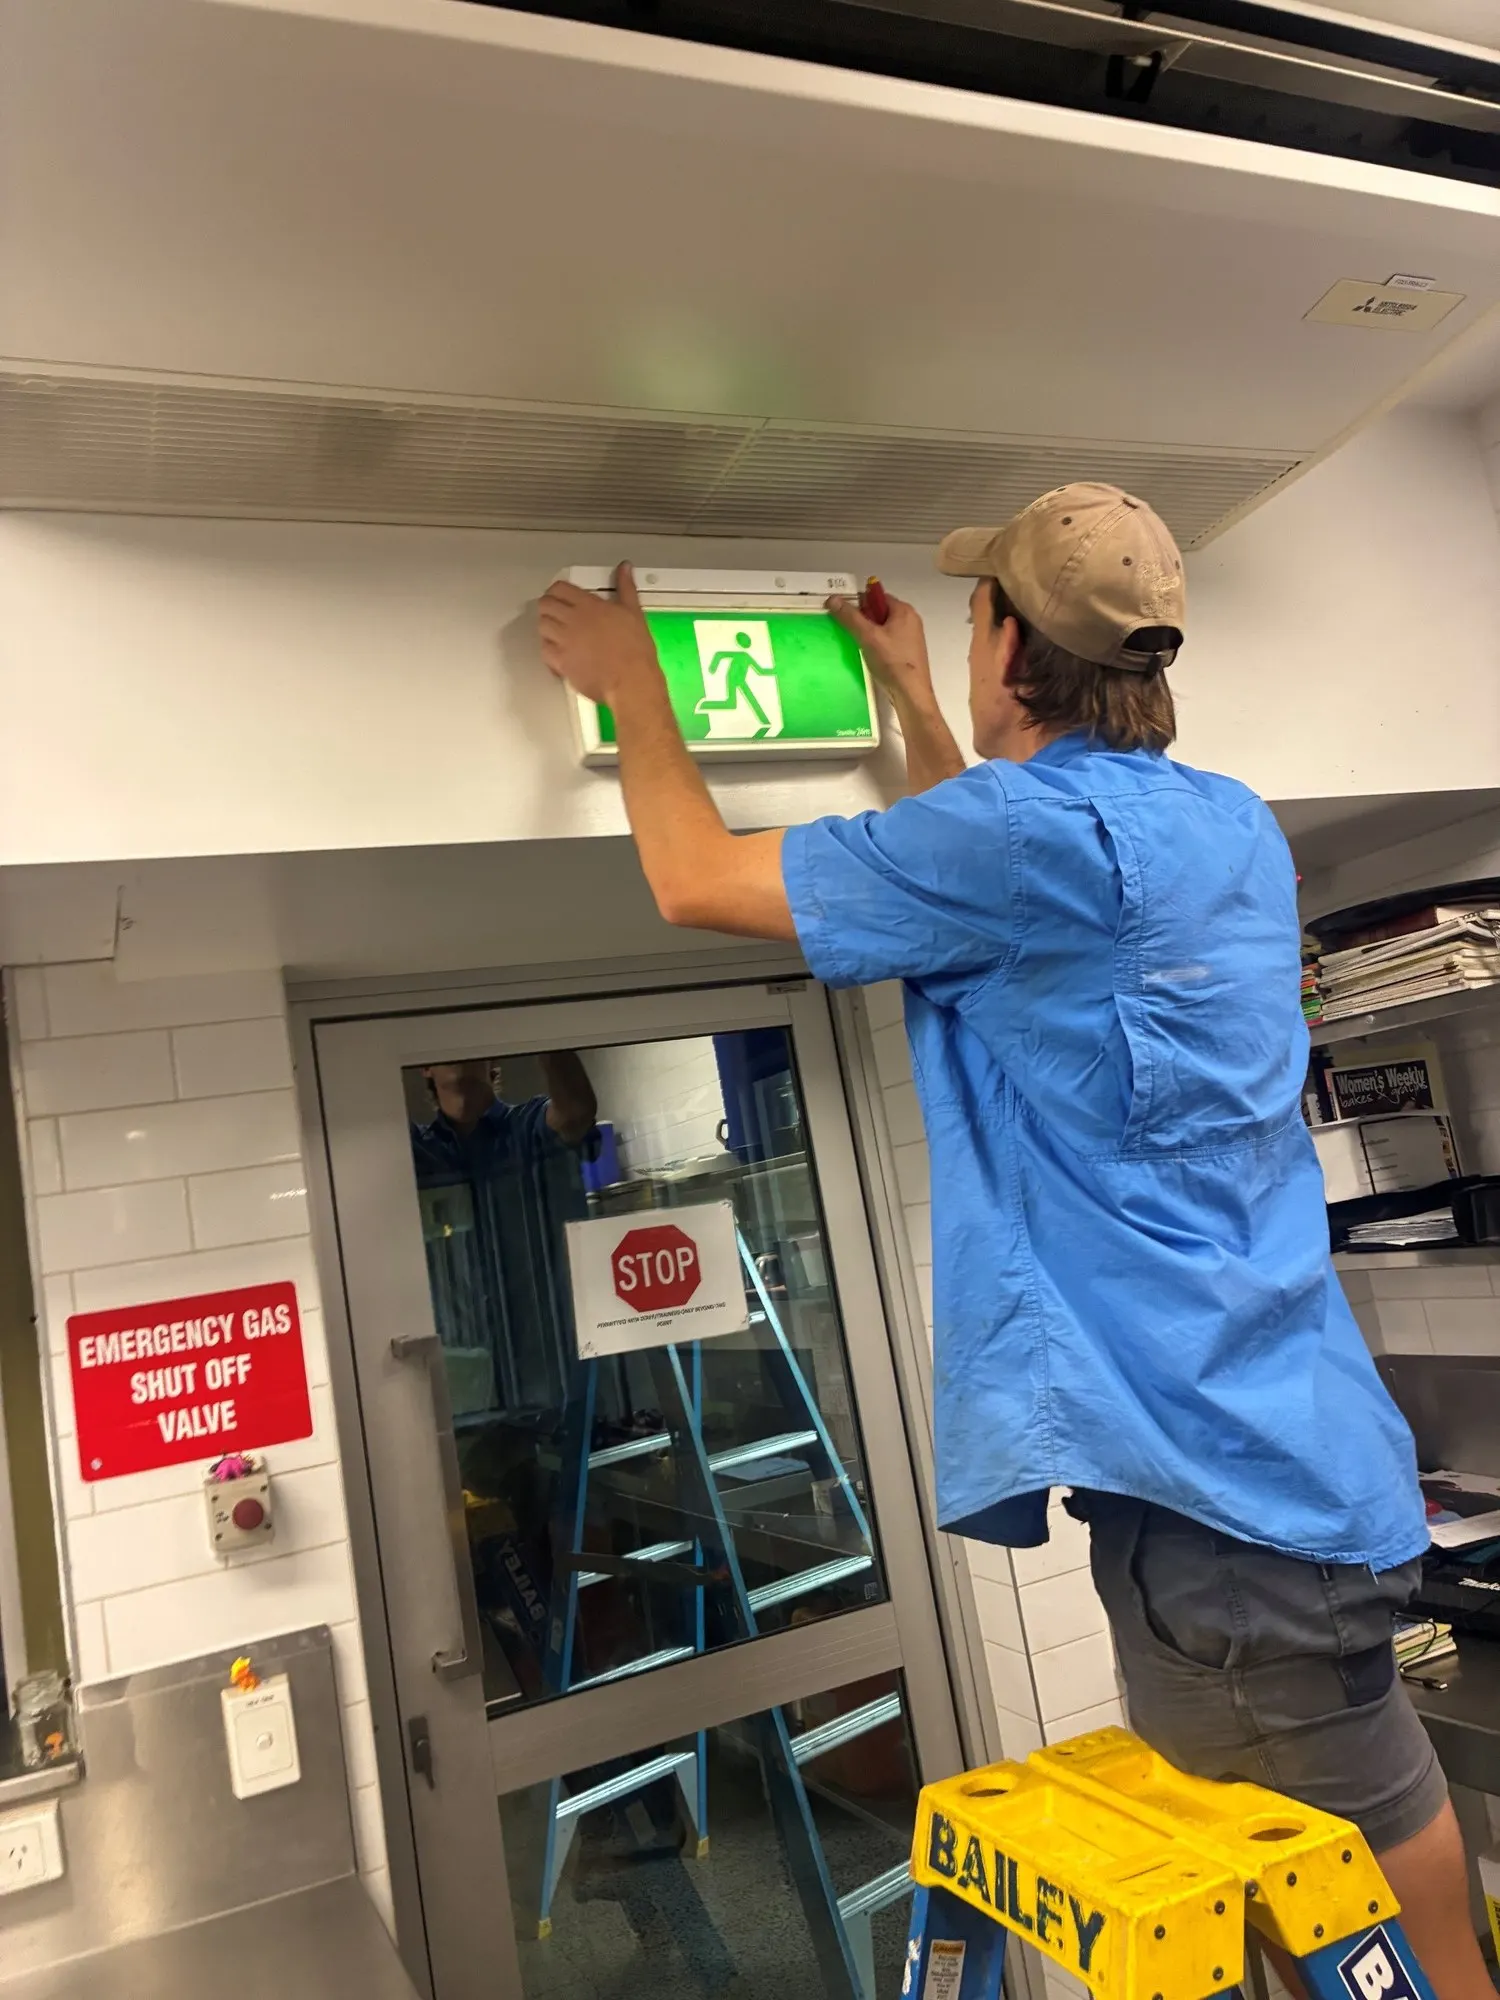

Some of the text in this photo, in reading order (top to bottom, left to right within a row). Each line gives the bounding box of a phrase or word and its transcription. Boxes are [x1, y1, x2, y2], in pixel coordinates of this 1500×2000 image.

[1335, 1065, 1425, 1095] Women's Weekly
[617, 1246, 694, 1292] STOP
[78, 1303, 292, 1369] EMERGENCY GAS
[130, 1352, 252, 1405] SHUT OFF
[156, 1399, 238, 1444] VALVE
[928, 1811, 1106, 1973] BAILEY
[1351, 1942, 1409, 2000] B
